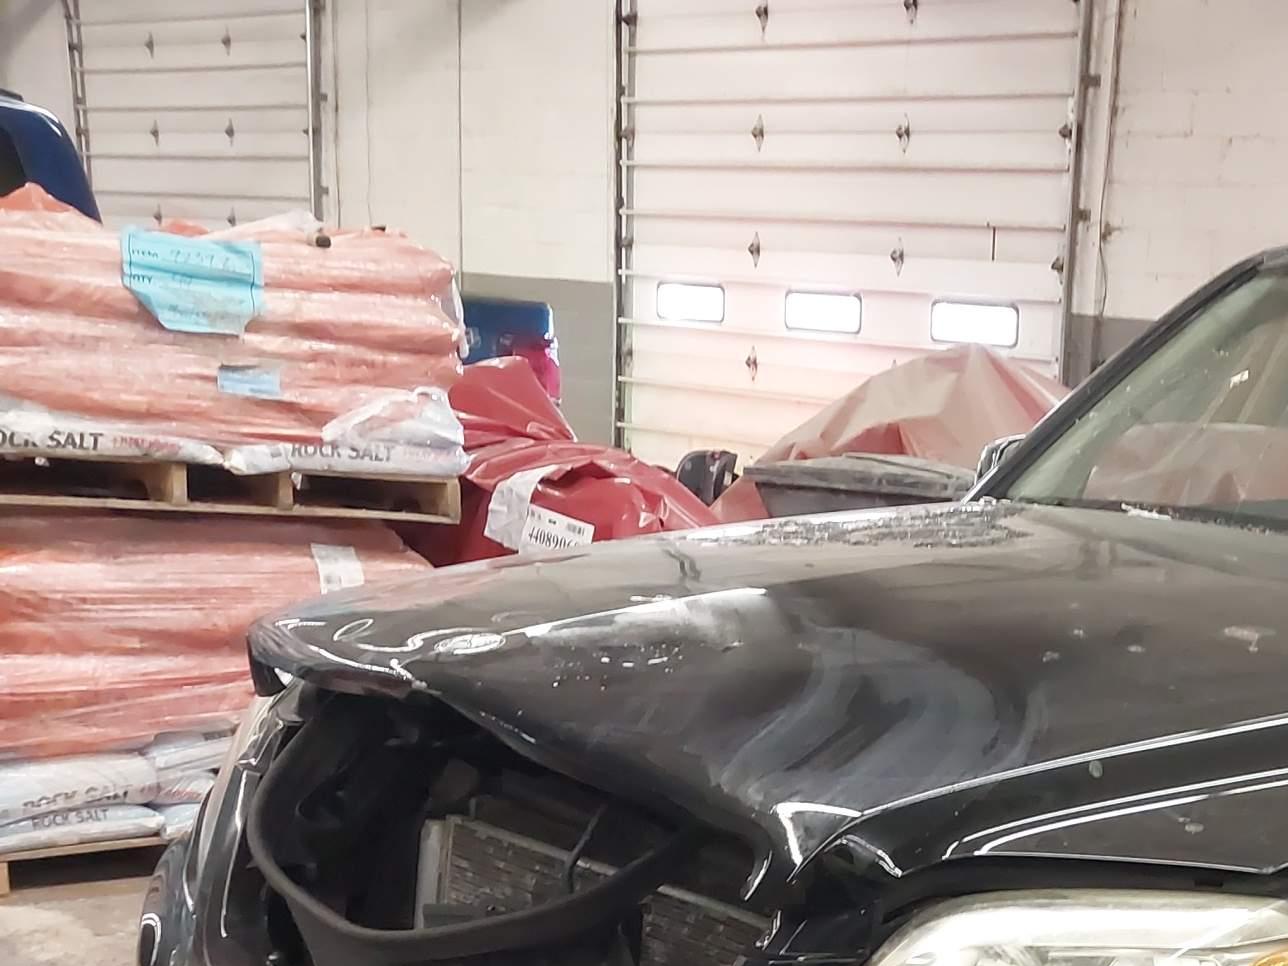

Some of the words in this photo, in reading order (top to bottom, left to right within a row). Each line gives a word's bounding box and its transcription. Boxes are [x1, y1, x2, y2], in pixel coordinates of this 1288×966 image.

[46, 430, 104, 451] SALT
[347, 447, 395, 463] SALT
[31, 814, 71, 830] ROCK
[77, 808, 110, 824] SALT
